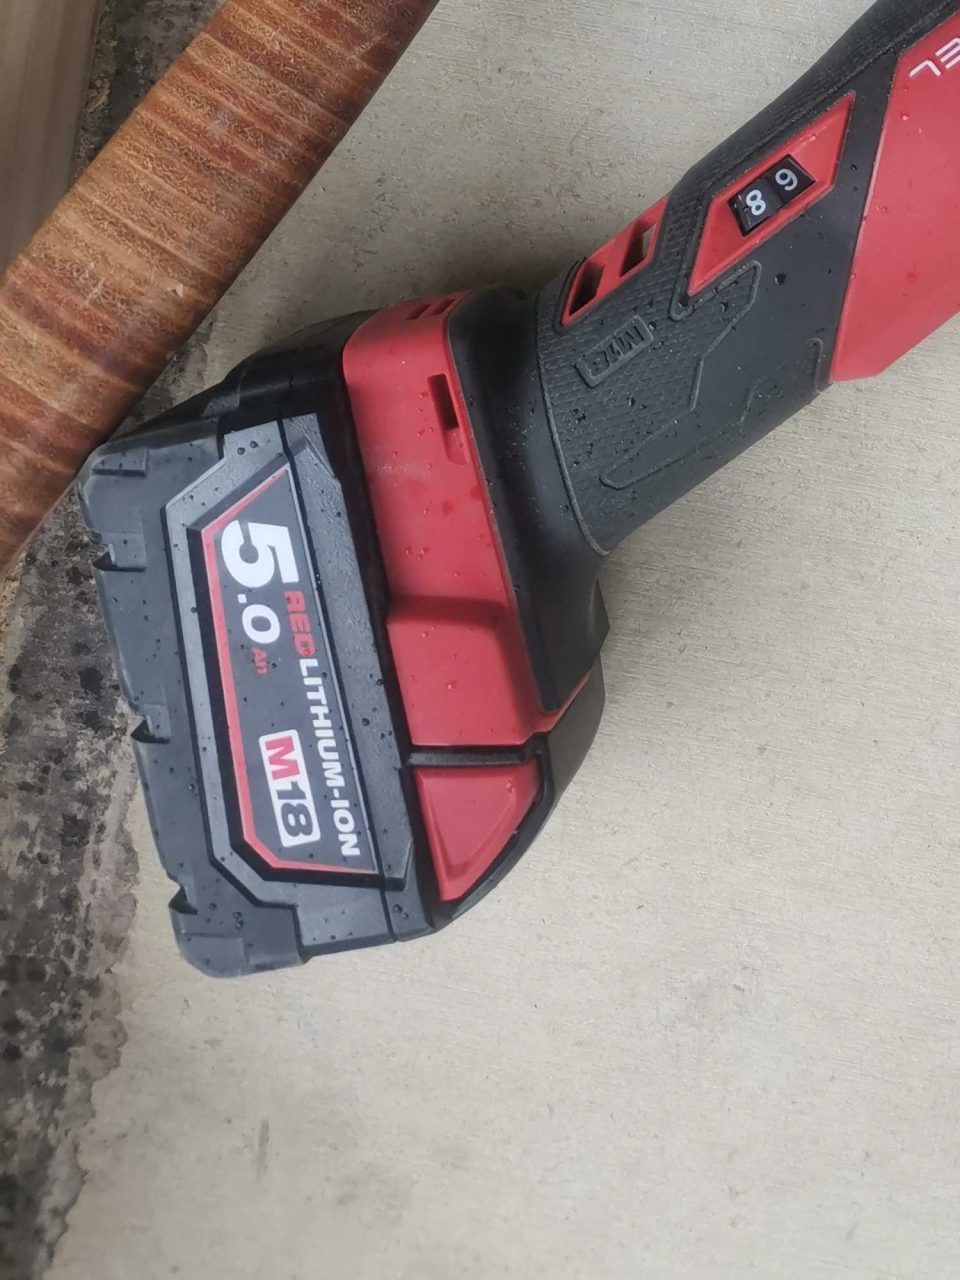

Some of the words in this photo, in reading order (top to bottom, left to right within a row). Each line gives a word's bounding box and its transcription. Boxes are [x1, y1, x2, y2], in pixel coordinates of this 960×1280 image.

[746, 189, 767, 216] 8
[221, 520, 299, 644] 5.0
[264, 734, 316, 839] M18
